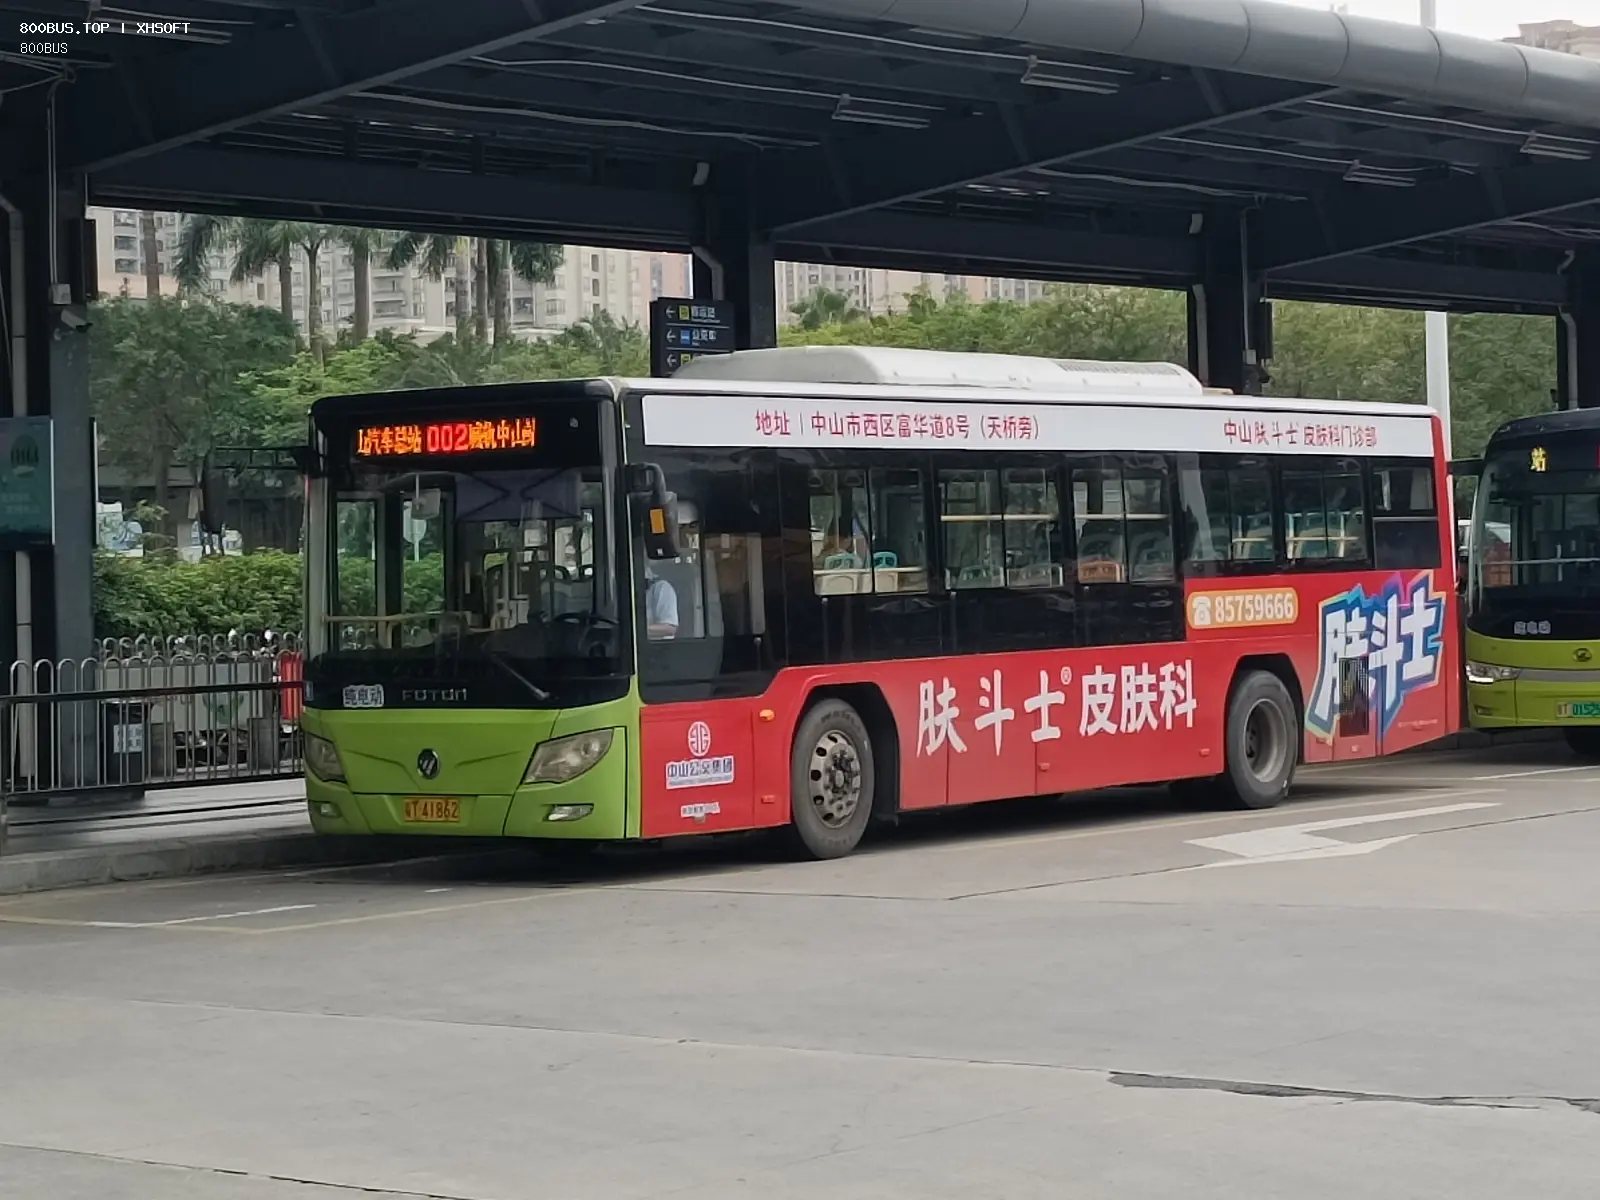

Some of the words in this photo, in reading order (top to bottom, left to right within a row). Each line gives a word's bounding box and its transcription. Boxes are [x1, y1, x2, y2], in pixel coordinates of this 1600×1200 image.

[426, 423, 469, 452] 002
[755, 409, 791, 436] 地址
[1215, 592, 1294, 624] 85759666
[1079, 659, 1198, 737] 皮肤科
